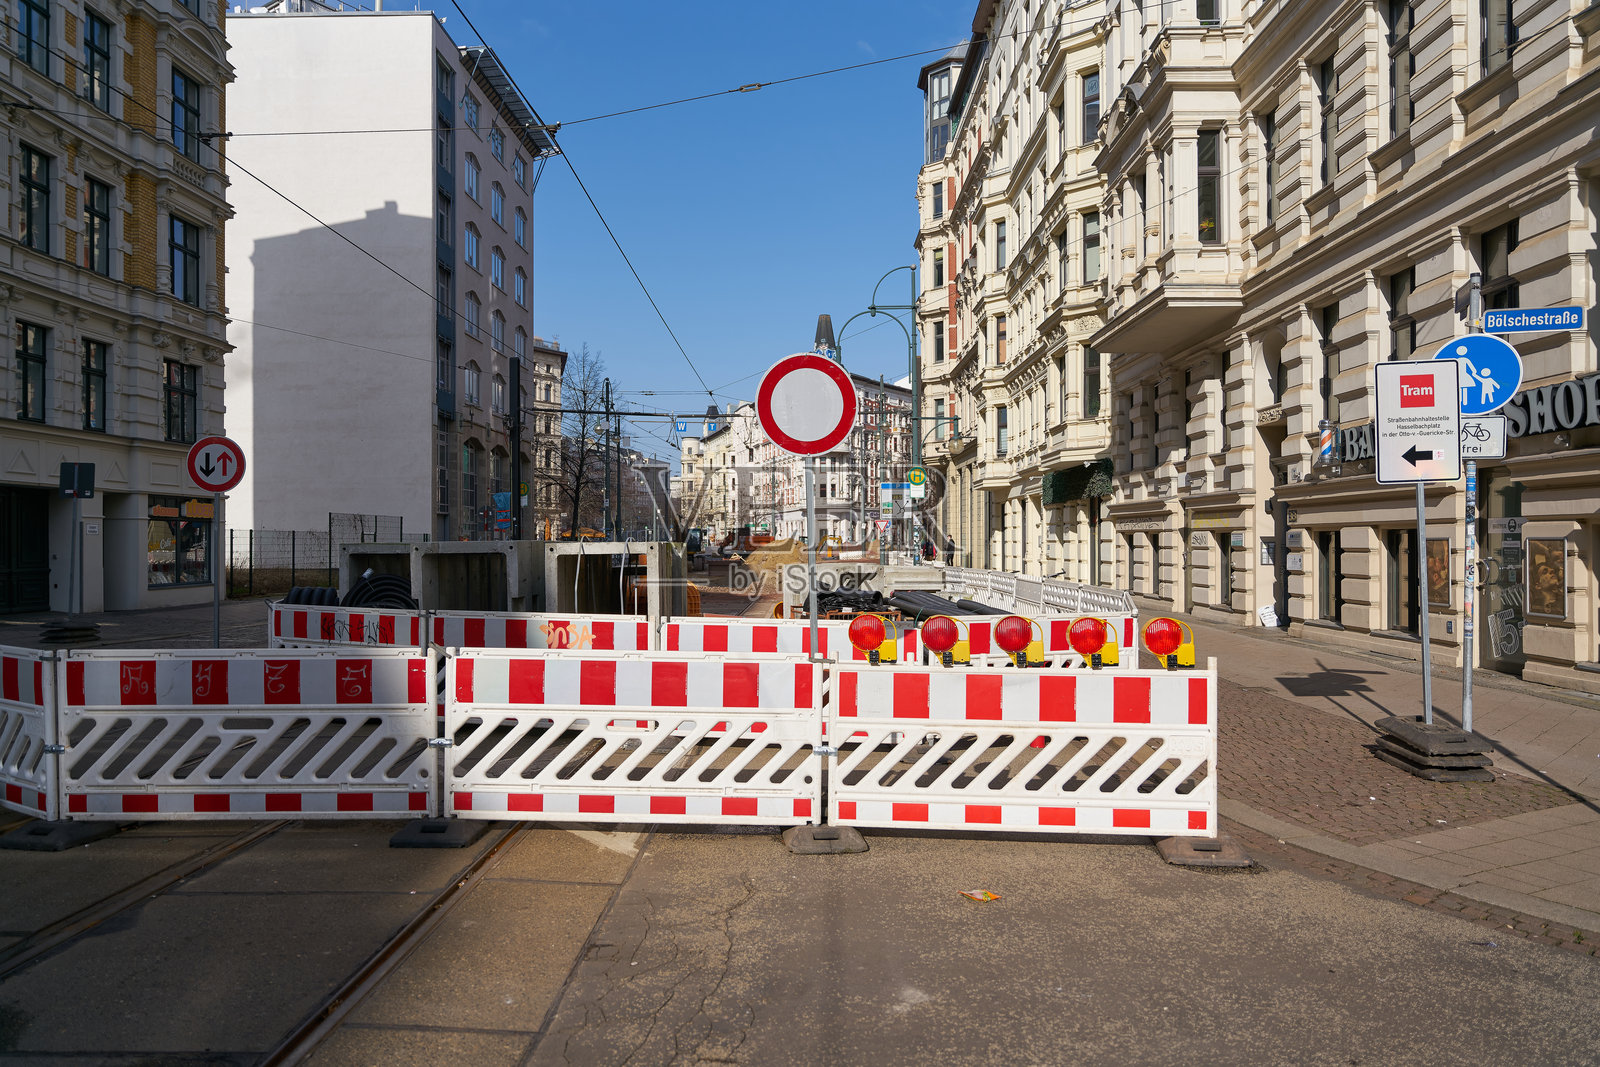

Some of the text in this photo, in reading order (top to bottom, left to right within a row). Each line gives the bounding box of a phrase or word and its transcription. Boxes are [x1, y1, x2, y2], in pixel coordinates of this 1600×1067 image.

[1487, 311, 1578, 328] Bölschestraße
[1401, 384, 1433, 396] Tram
[1387, 415, 1450, 423] Straßenbahnhaltestelle
[677, 422, 686, 431] W
[1344, 424, 1375, 462] BA
[1462, 444, 1482, 453] frei
[913, 470, 922, 481] H
